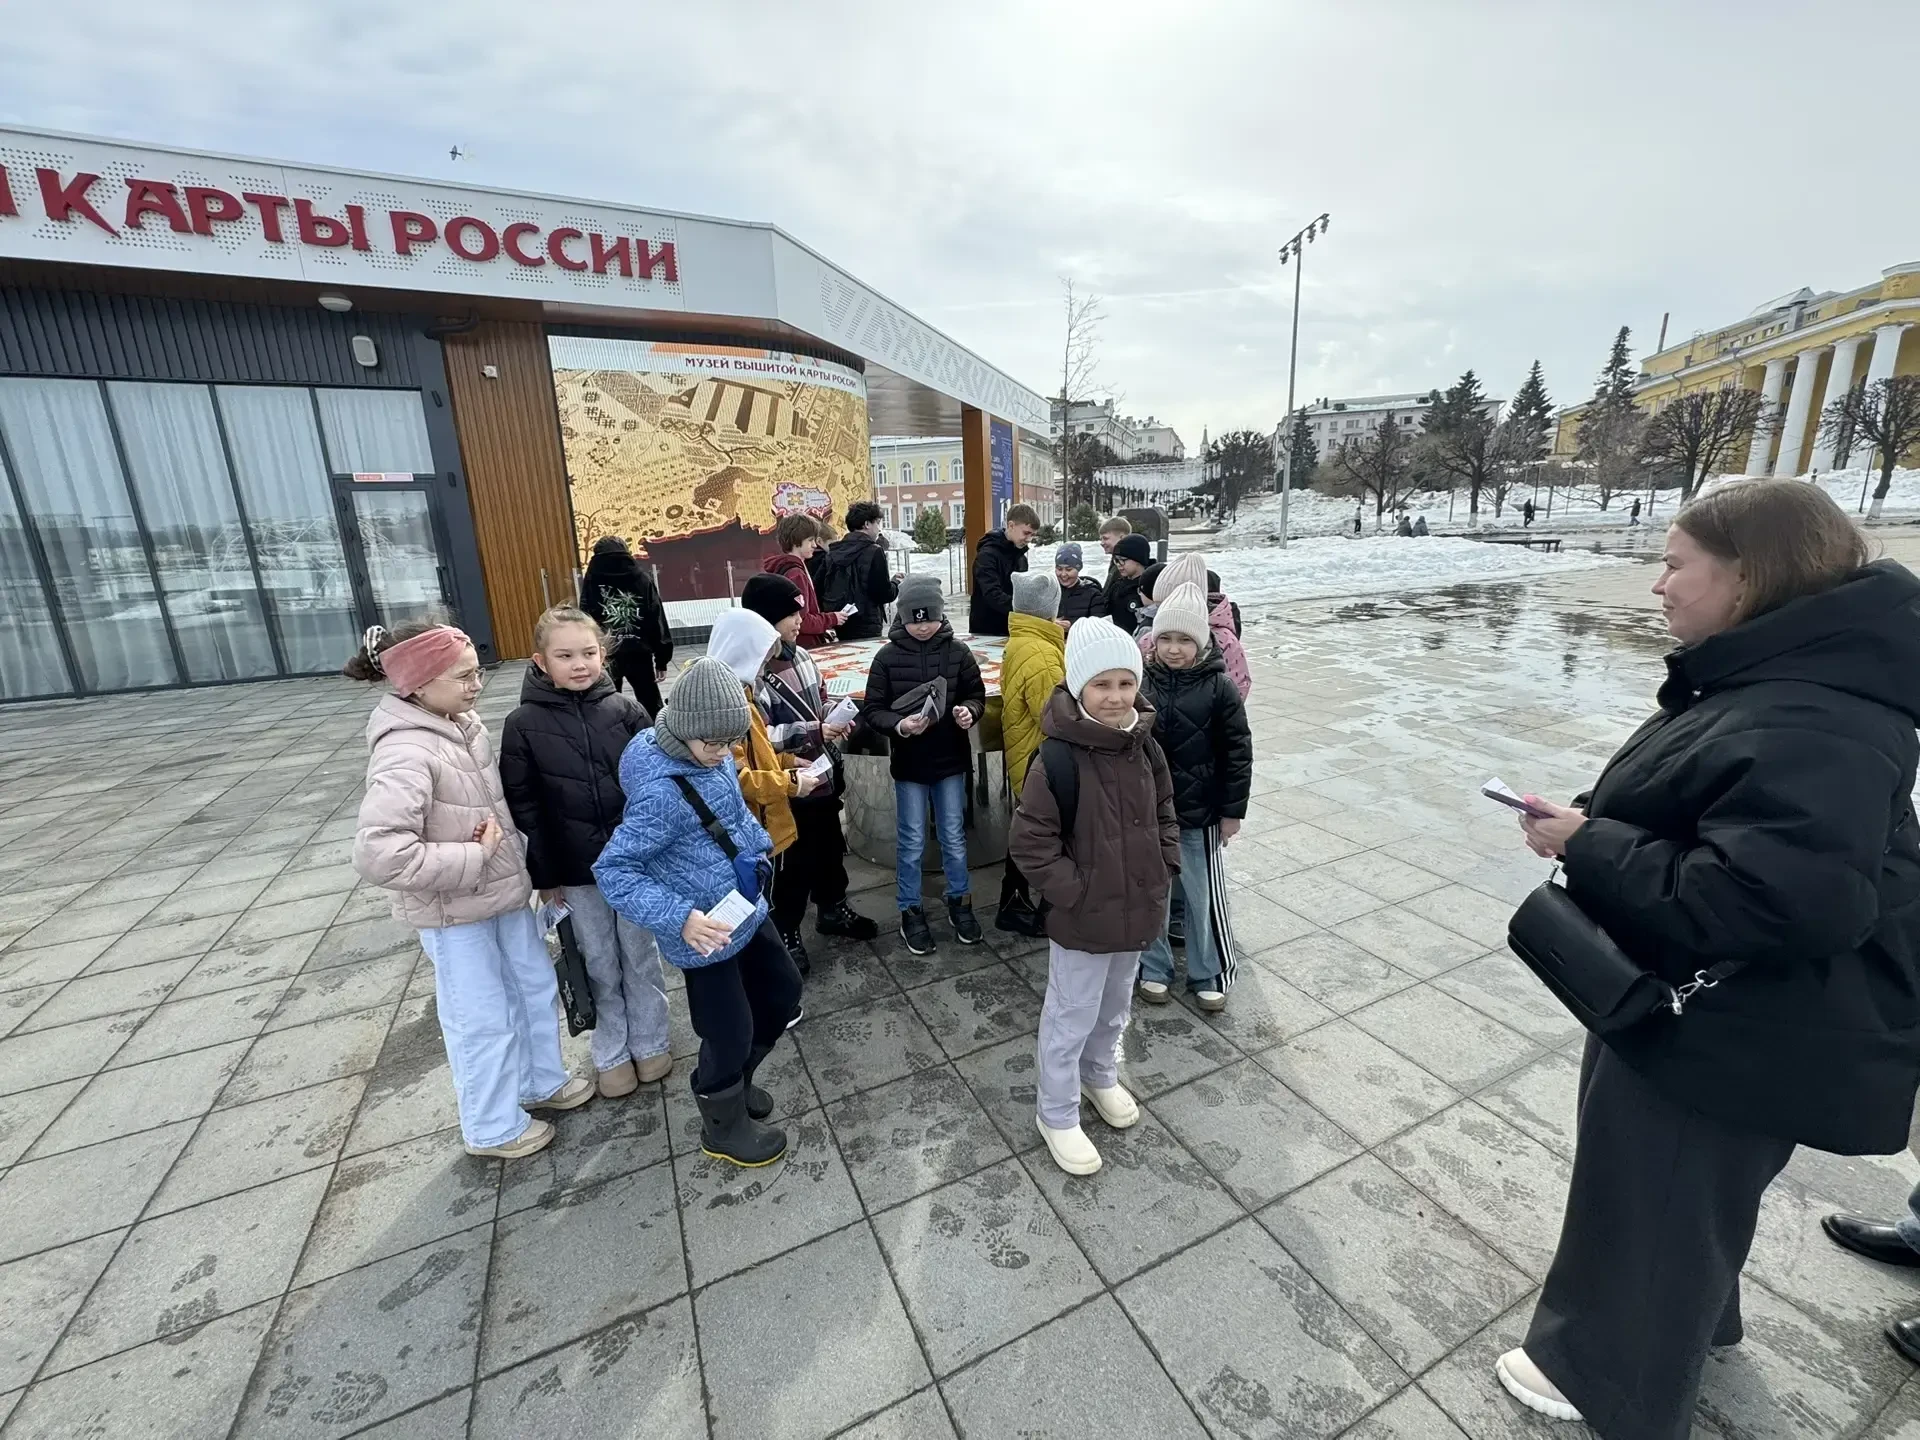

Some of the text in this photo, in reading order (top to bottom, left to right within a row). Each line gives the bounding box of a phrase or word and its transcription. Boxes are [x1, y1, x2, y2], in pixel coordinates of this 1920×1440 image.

[35, 166, 371, 252] КАРТЫ
[389, 209, 679, 283] РОССИИ
[685, 357, 730, 369] МУЗЕЙ
[734, 360, 798, 375] ВЫШИТОЙ
[799, 367, 831, 381] КАРТЫ
